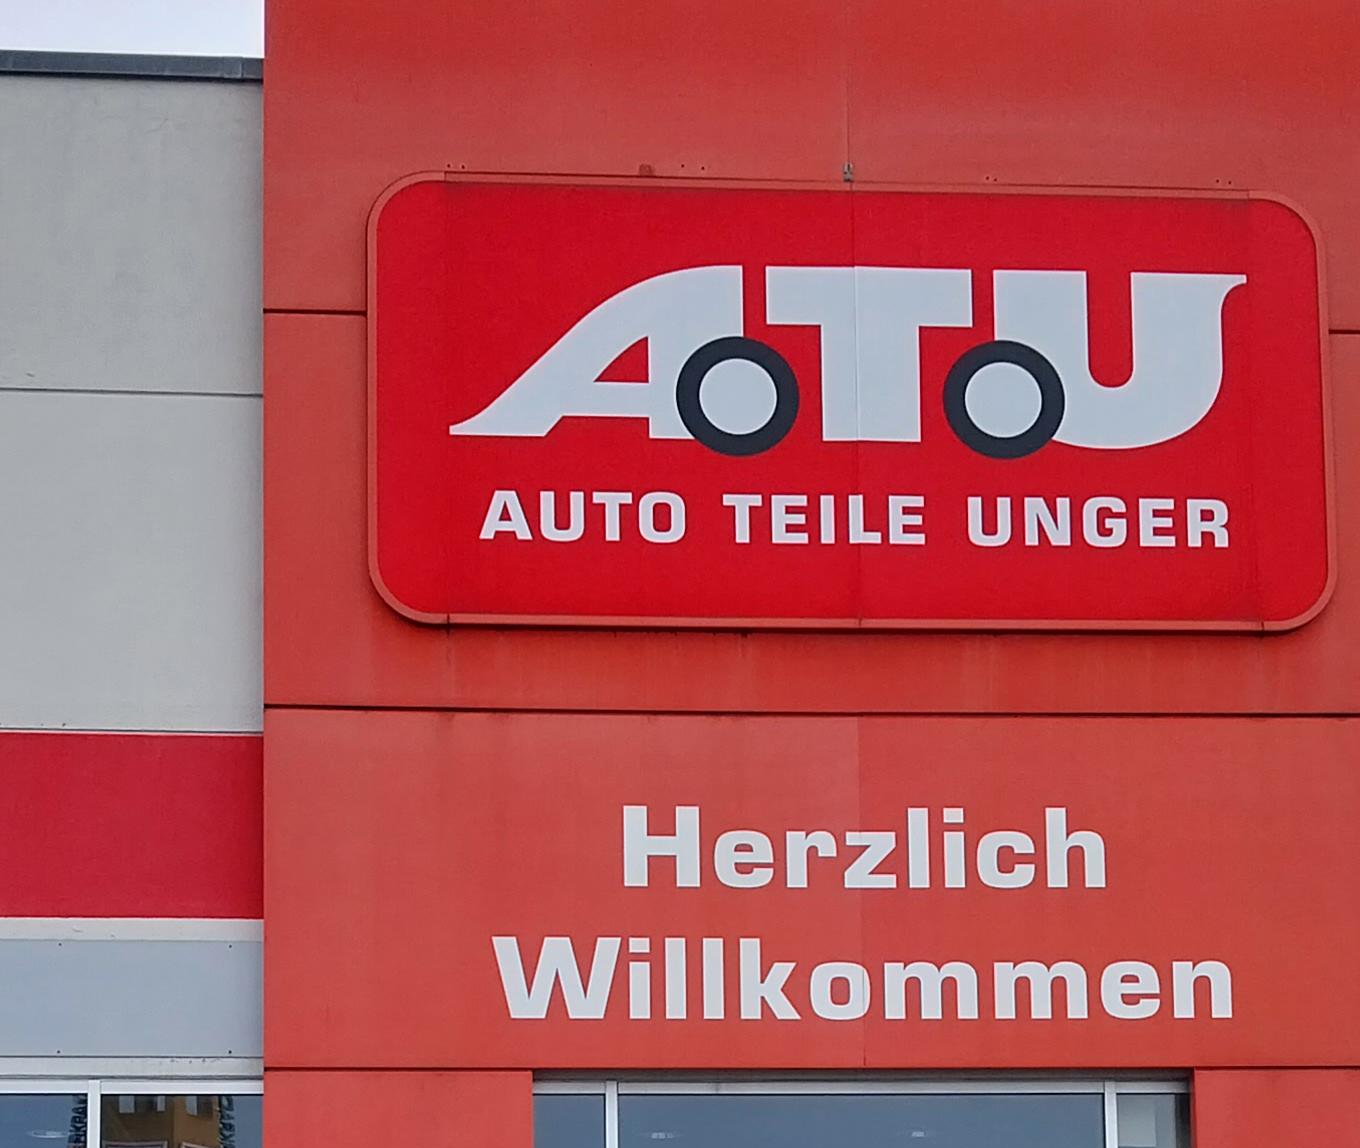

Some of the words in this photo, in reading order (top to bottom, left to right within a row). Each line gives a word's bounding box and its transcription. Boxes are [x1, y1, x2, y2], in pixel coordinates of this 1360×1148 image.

[479, 490, 686, 542] AUTO
[722, 494, 925, 545] TEILE
[966, 496, 1230, 548] UNGER
[622, 805, 1106, 889] Herzlich
[491, 936, 1233, 1020] Willkommen
